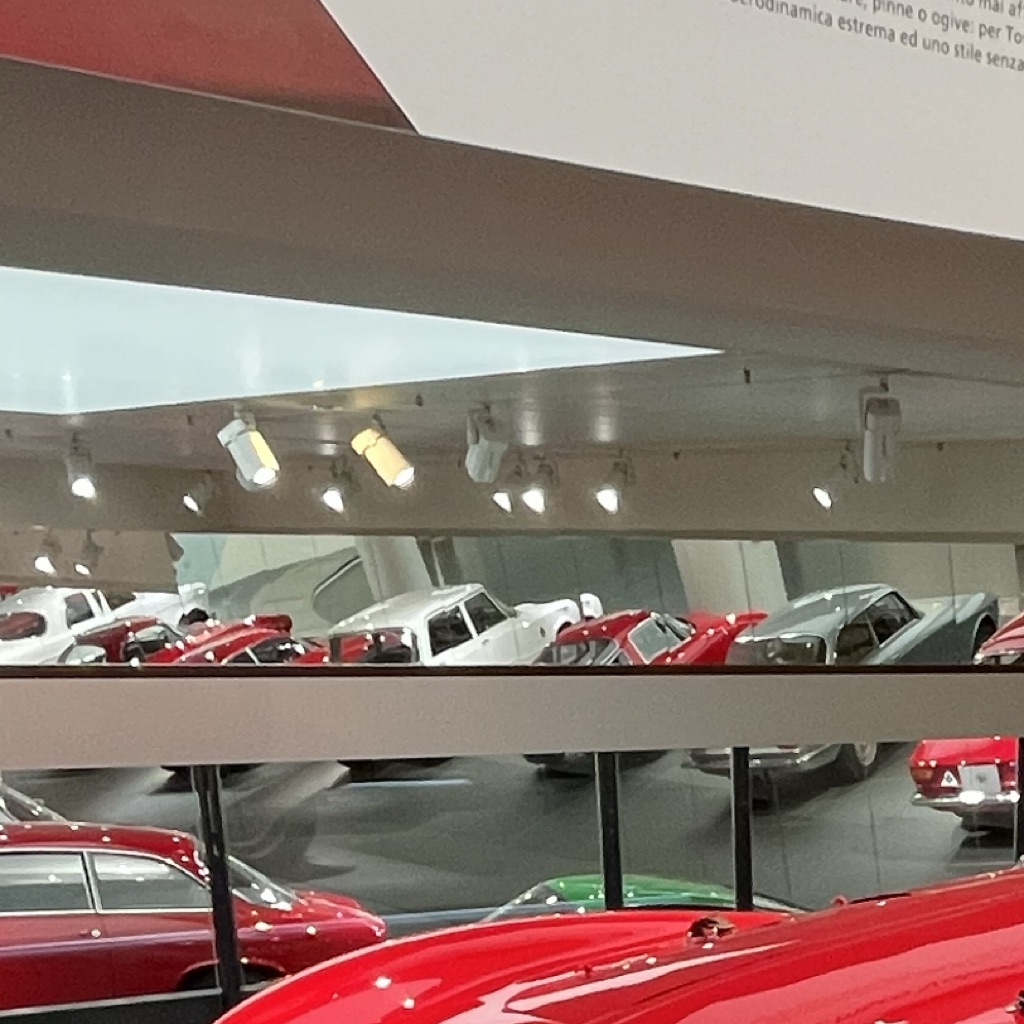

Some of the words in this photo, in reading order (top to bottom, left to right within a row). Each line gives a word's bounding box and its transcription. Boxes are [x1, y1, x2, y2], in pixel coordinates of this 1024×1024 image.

[837, 15, 896, 43] estrema
[900, 30, 918, 48] ed
[922, 37, 951, 56] uno
[954, 43, 982, 64] stile
[986, 51, 1024, 72] senza
[872, 0, 914, 19] pinne
[918, 8, 927, 22] o
[978, 22, 1002, 39] per
